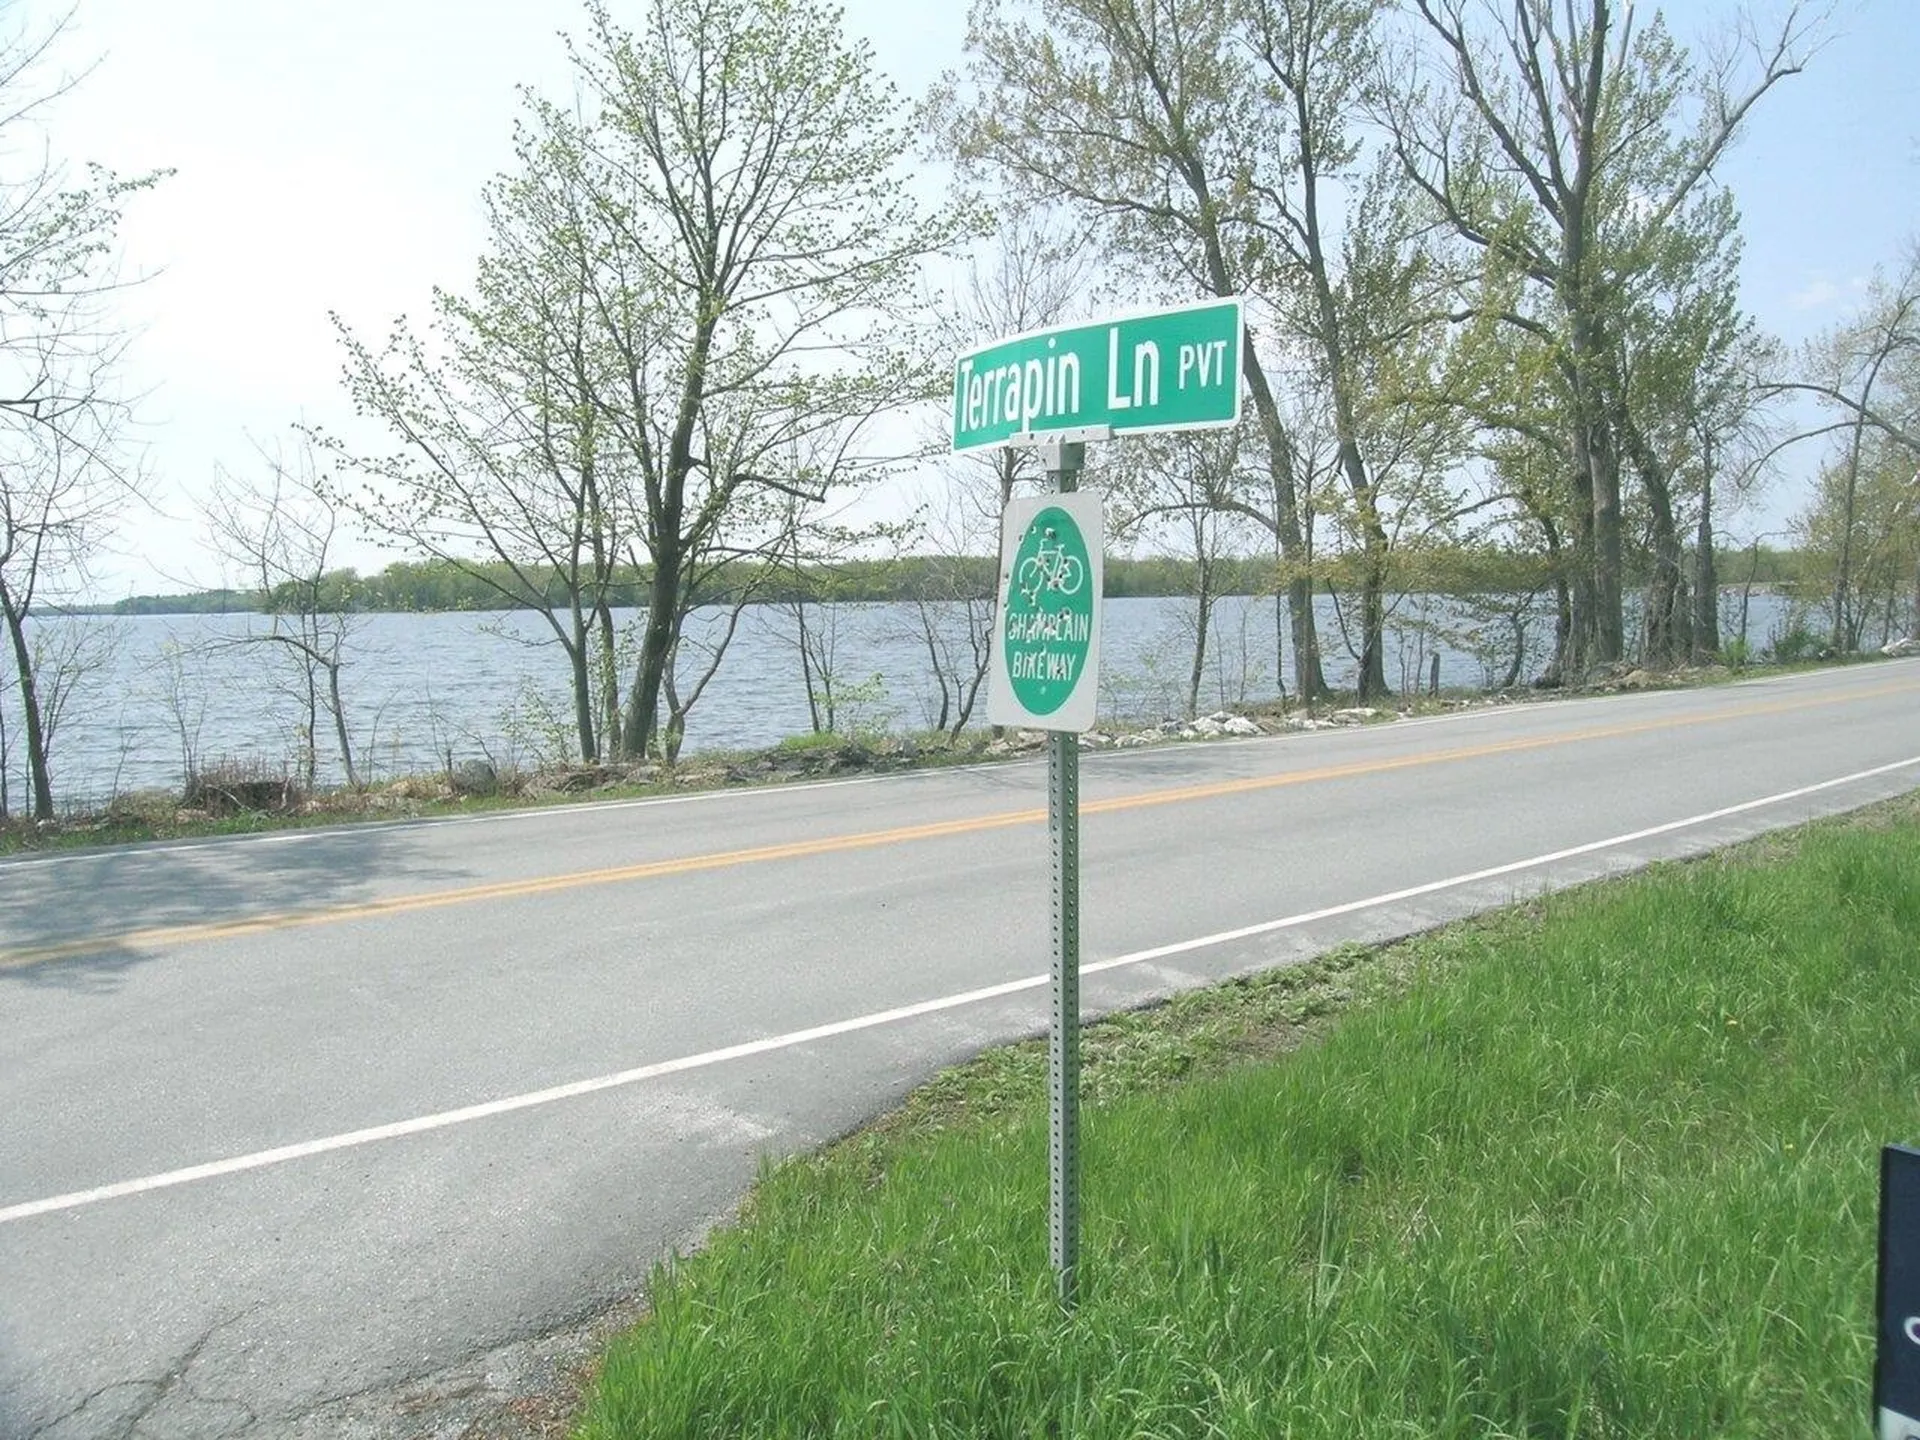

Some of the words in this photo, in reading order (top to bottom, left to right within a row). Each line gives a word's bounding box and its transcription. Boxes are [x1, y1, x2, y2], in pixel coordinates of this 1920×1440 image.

[961, 338, 1080, 432] Terrapin
[1108, 327, 1159, 410] Ln
[1178, 340, 1227, 390] PVT
[1012, 652, 1076, 681] BIKEWAY
